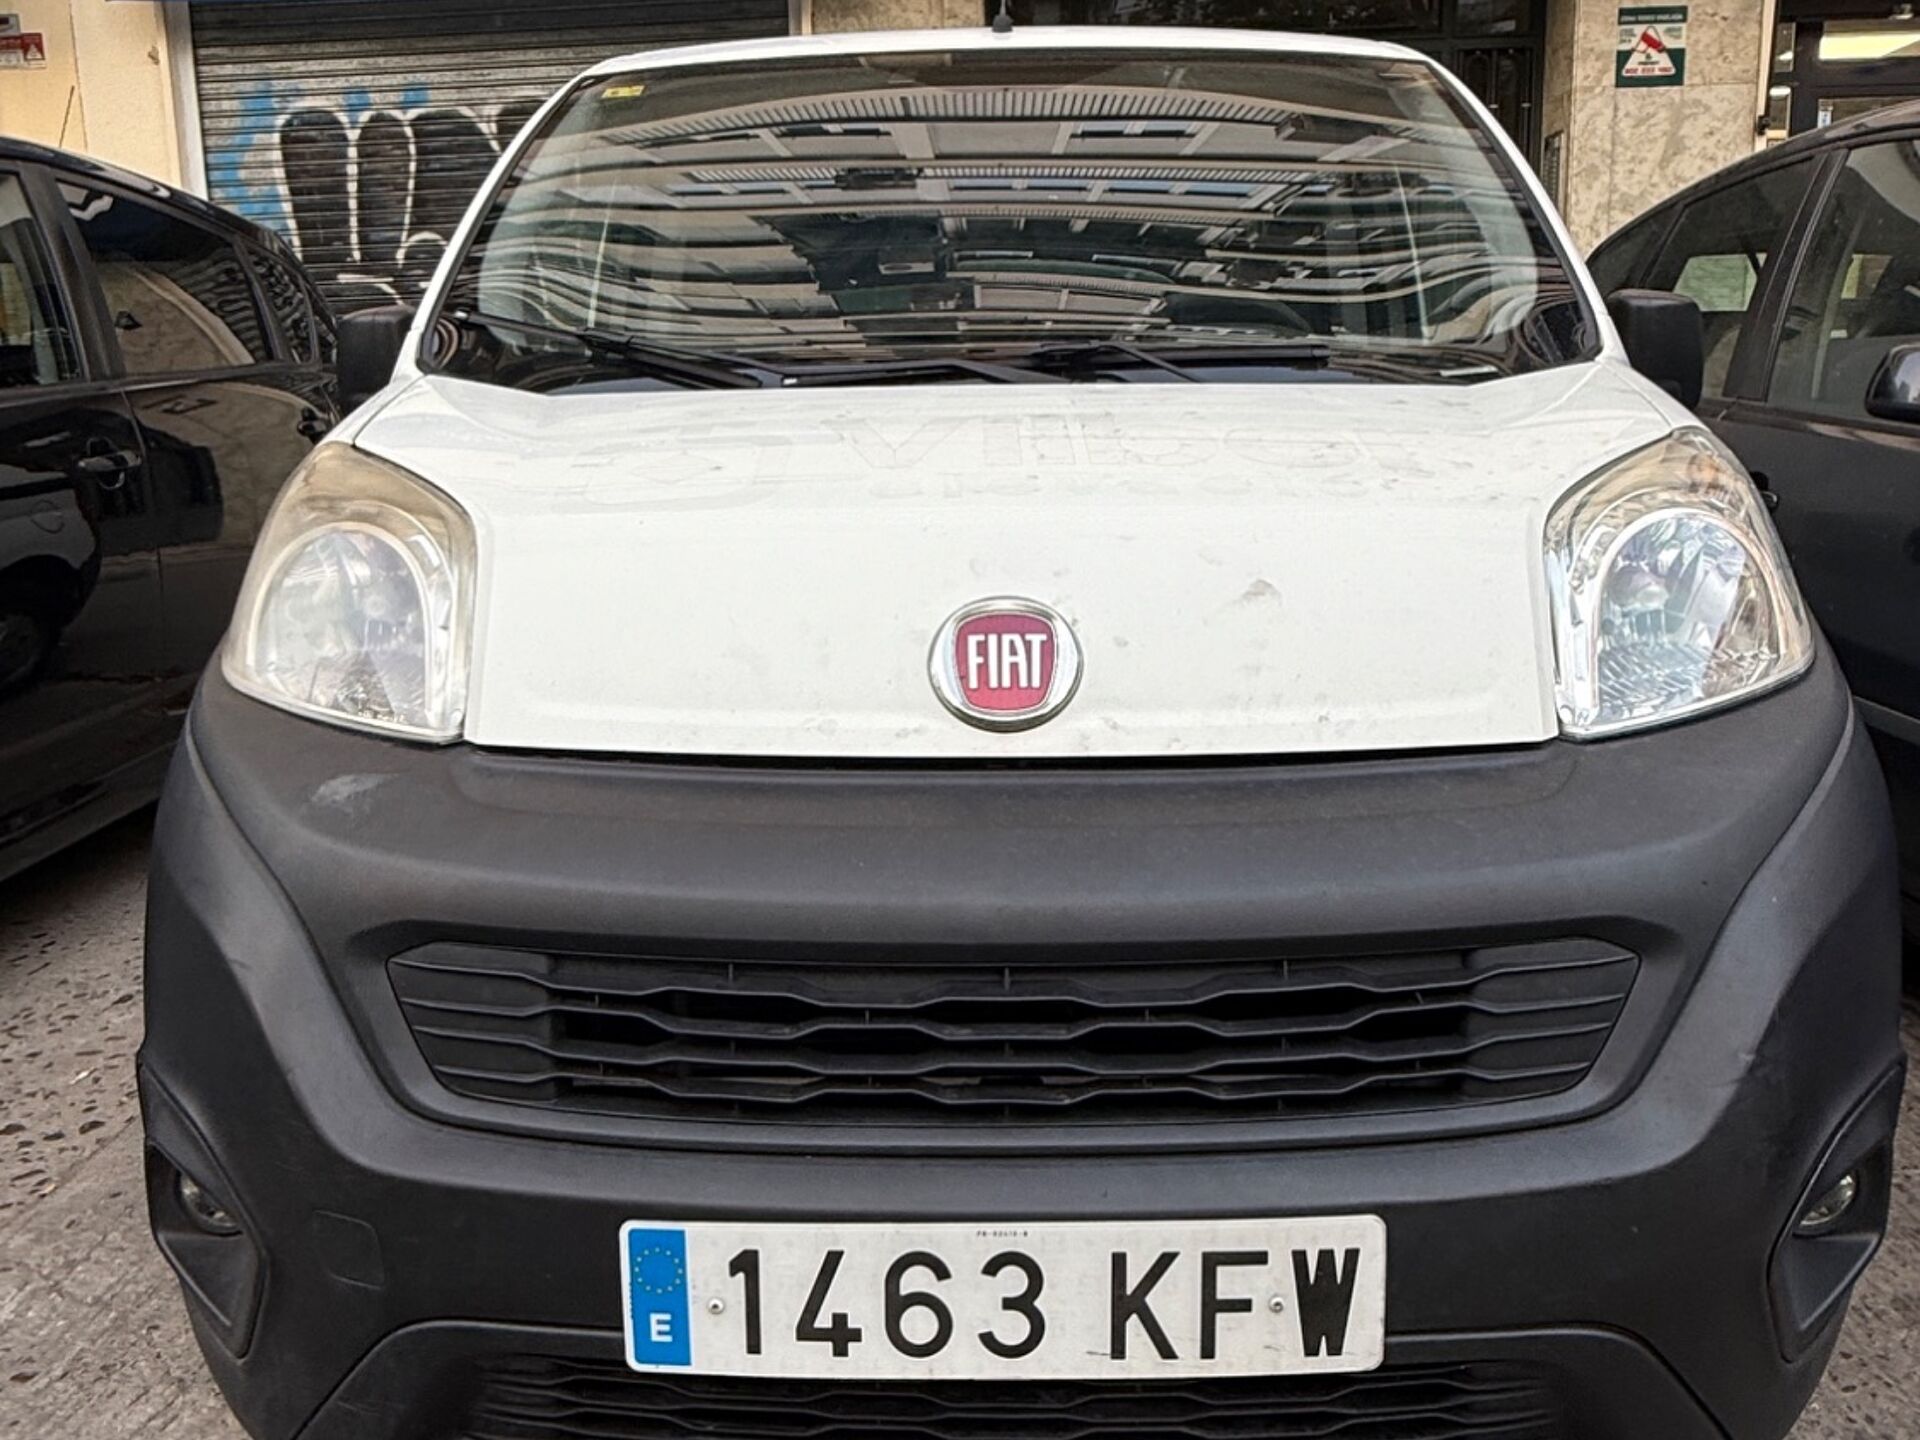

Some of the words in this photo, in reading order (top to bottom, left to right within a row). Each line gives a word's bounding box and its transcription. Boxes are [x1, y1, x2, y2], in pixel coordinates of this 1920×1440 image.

[967, 633, 1048, 690] FIAT
[649, 1312, 673, 1343] E
[729, 1248, 1046, 1359] 1463
[1110, 1247, 1361, 1360] KFW
